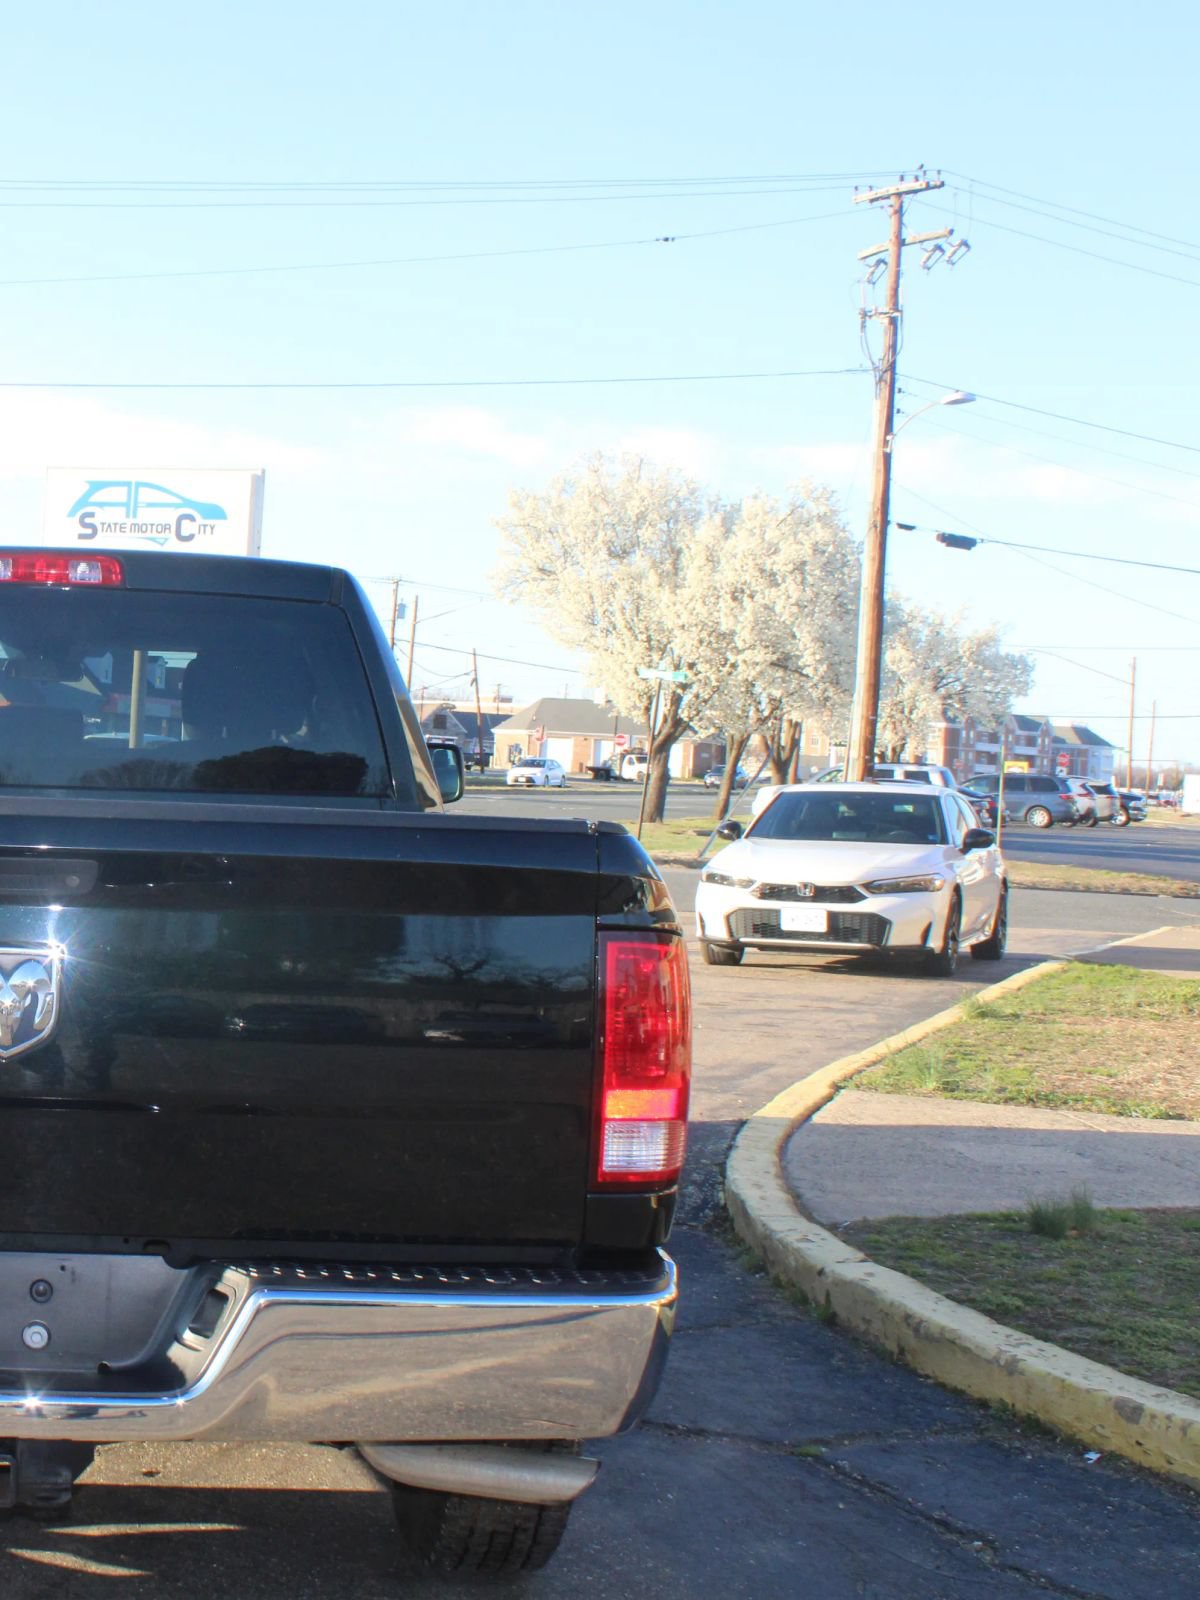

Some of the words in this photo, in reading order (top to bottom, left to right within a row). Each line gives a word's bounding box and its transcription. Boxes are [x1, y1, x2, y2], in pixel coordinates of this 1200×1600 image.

[78, 512, 127, 540] STATE
[130, 522, 171, 535] MOTOR
[175, 513, 216, 542] CITY
